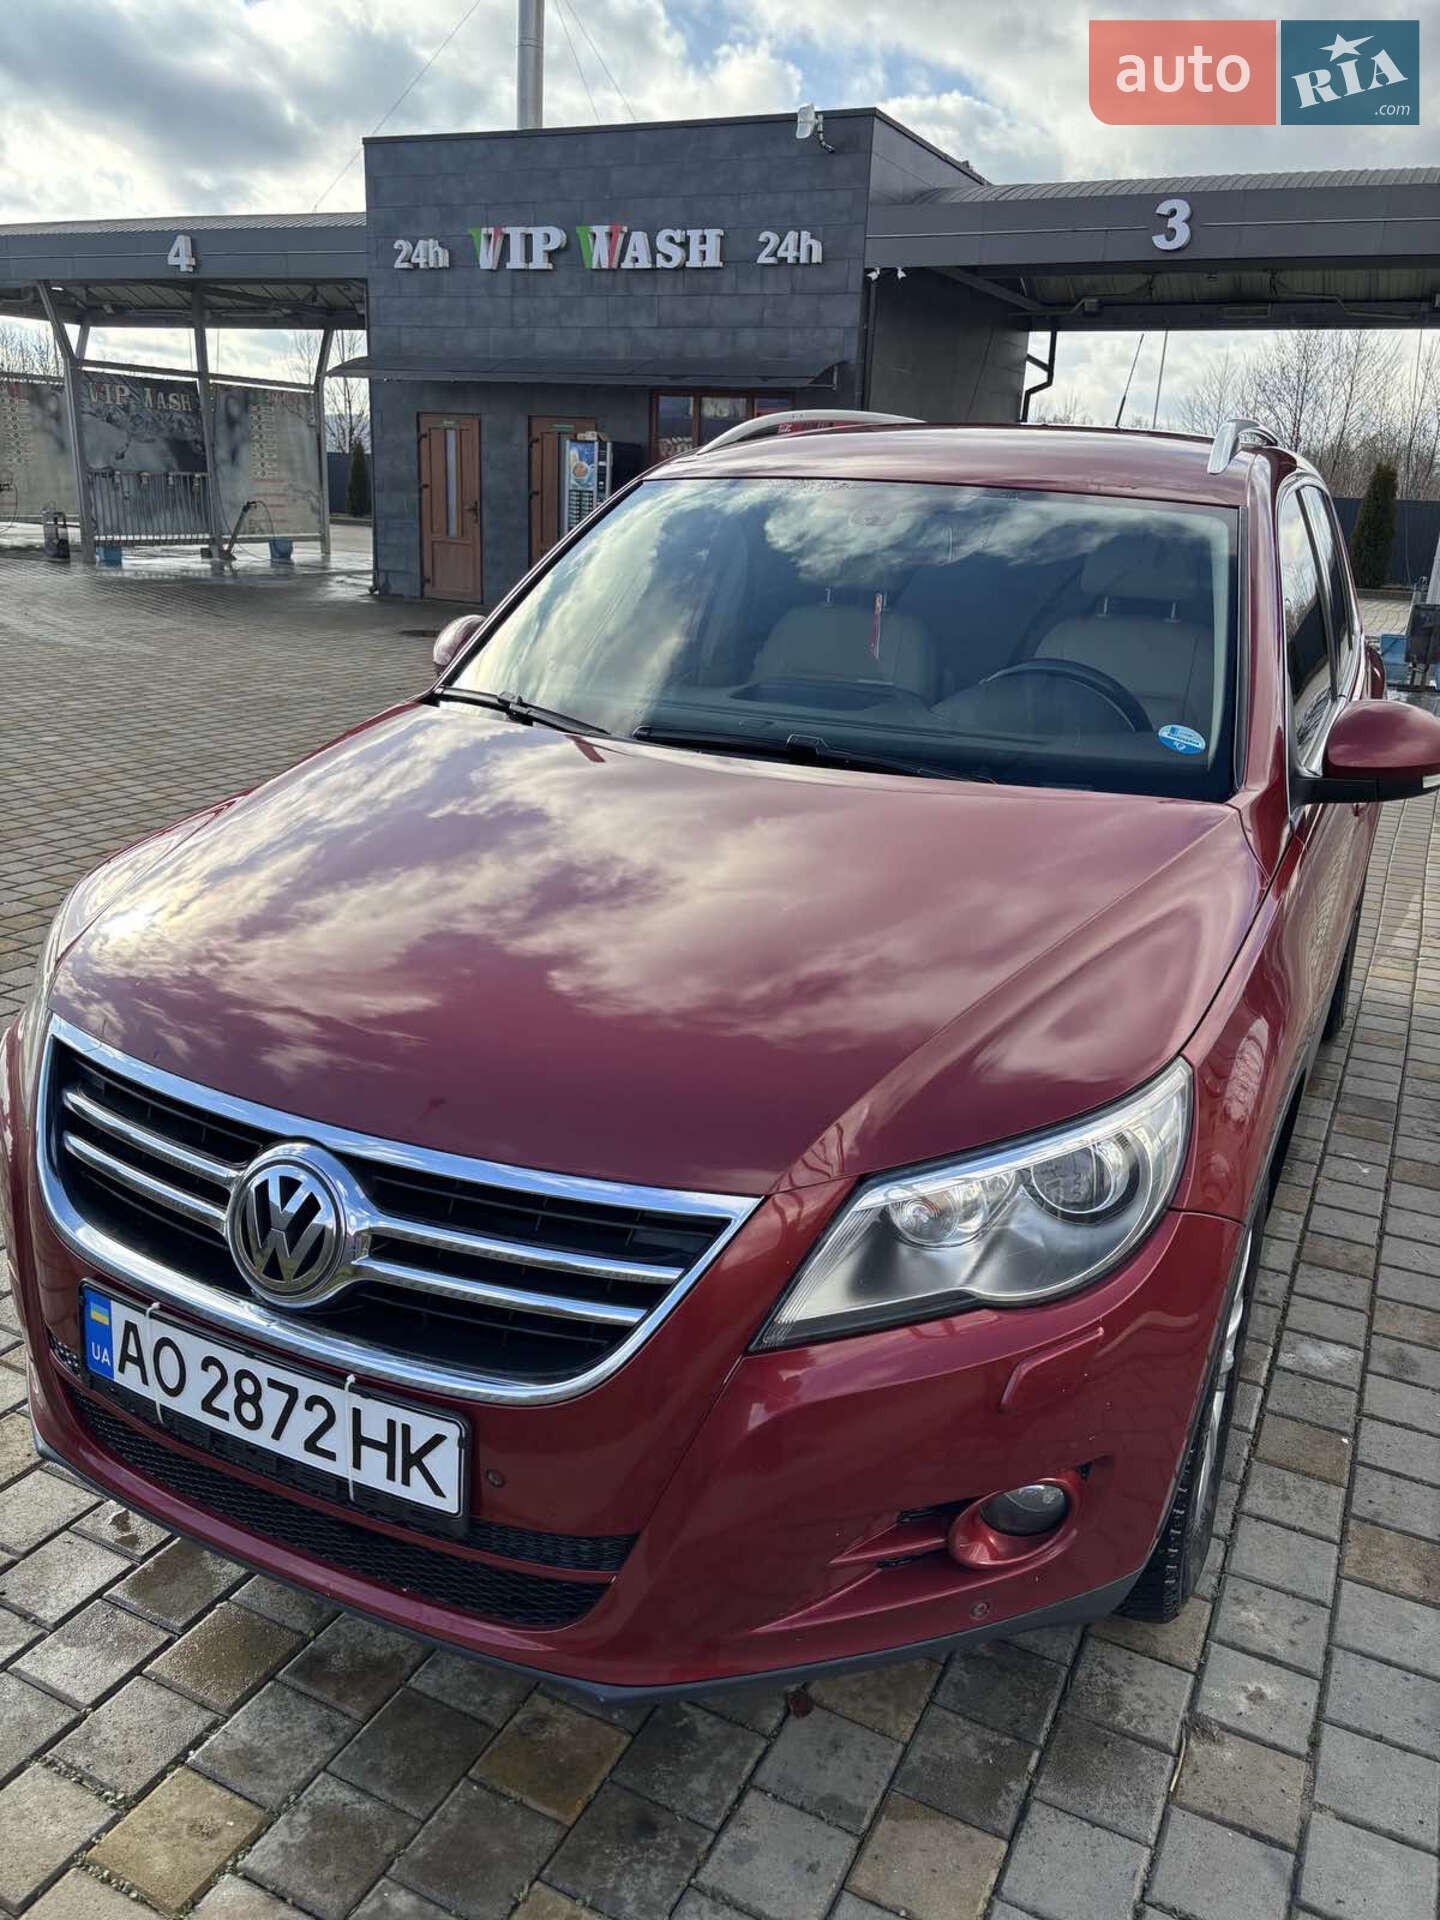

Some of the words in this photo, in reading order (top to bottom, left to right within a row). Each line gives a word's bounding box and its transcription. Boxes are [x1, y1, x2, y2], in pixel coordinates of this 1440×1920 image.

[1151, 198, 1193, 251] 3
[167, 234, 197, 272] 4
[393, 238, 450, 270] 24h
[468, 225, 567, 270] VIP
[576, 224, 724, 270] WASH
[756, 230, 823, 265] 24h
[86, 382, 131, 405] VIP
[91, 1344, 111, 1366] UA
[117, 1319, 187, 1398] AO
[200, 1355, 337, 1462] 2872
[351, 1407, 448, 1498] HK
